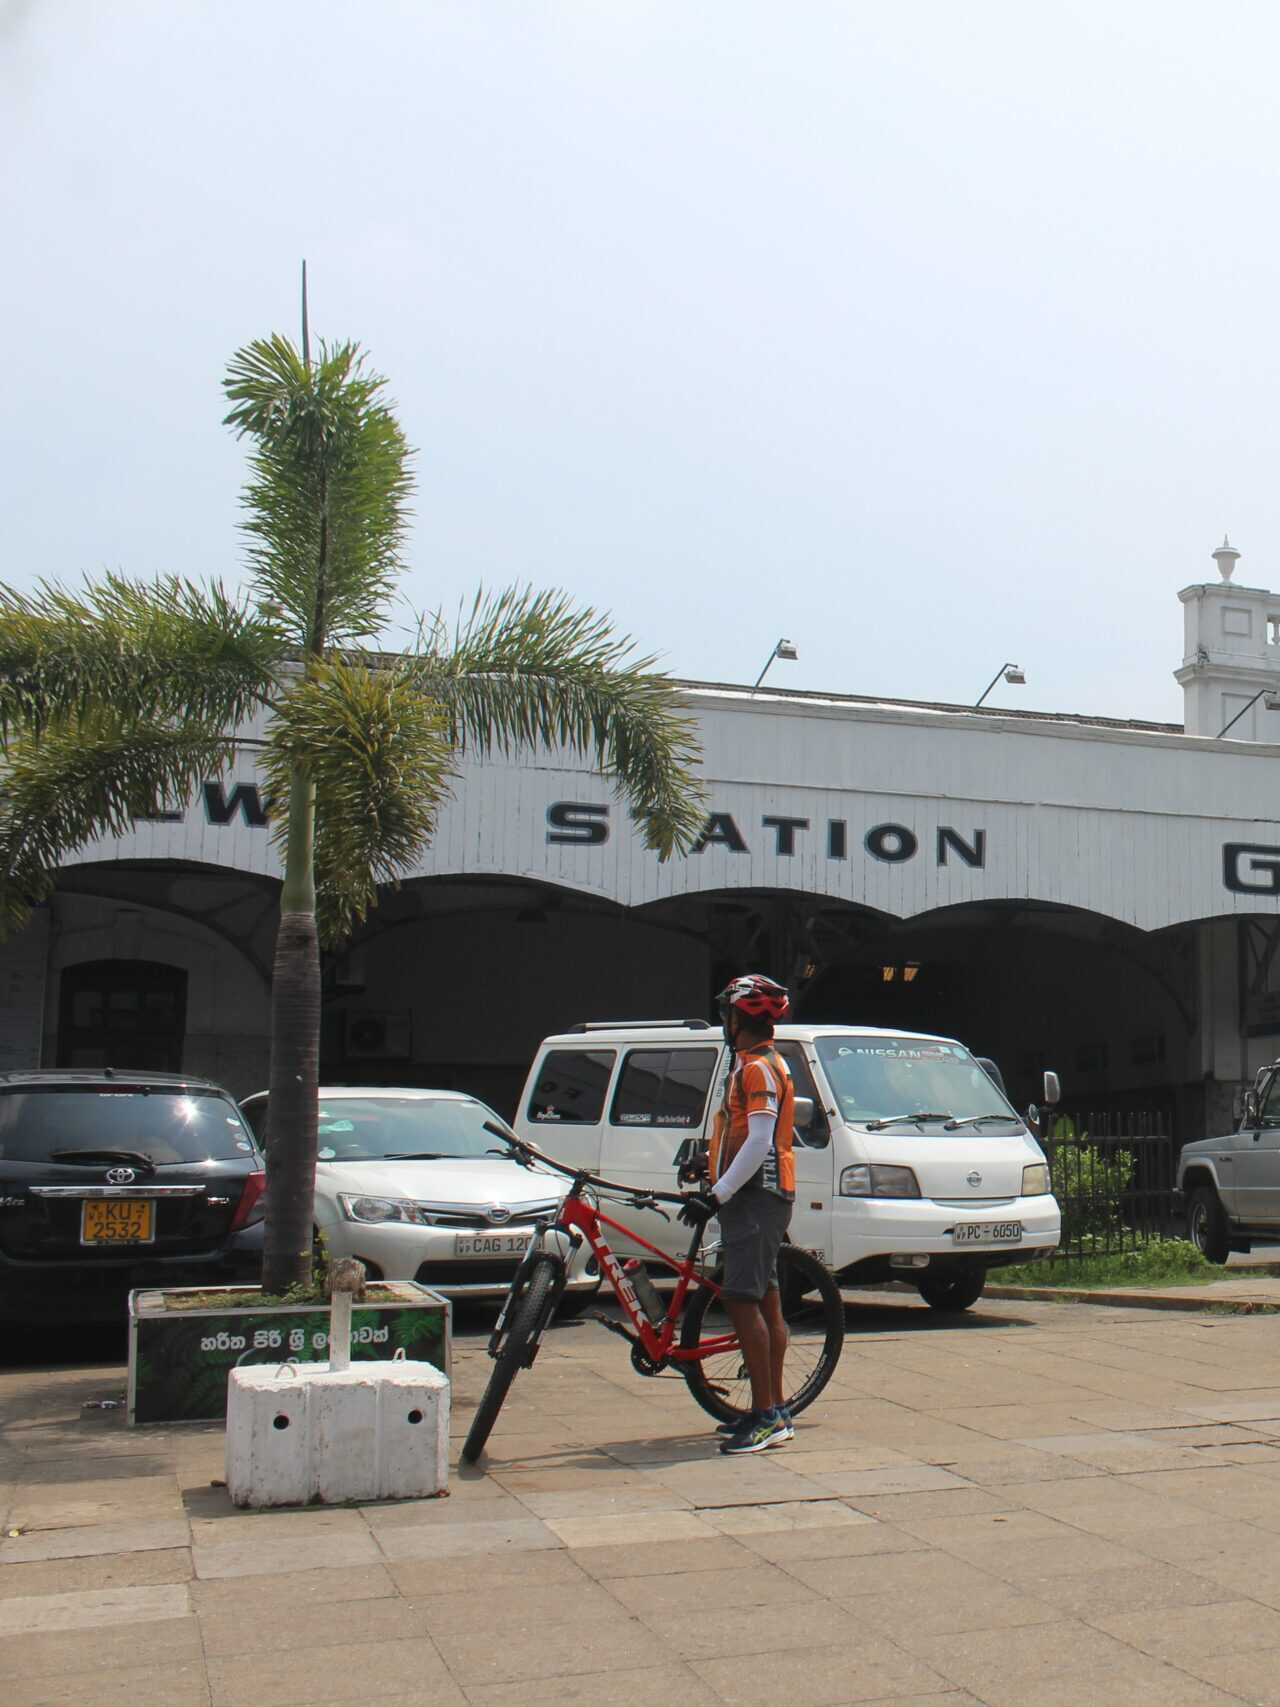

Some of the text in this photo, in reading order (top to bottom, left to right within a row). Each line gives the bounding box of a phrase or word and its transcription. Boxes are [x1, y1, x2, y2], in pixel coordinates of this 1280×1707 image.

[546, 800, 986, 869] SATION
[856, 1048, 921, 1058] NISSAN
[105, 1203, 131, 1221] KU
[93, 1221, 141, 1239] 2532
[473, 1238, 500, 1253] CAG
[594, 1237, 649, 1328] TREK
[200, 1332, 246, 1351] හරිත
[253, 1329, 282, 1349] පිරි
